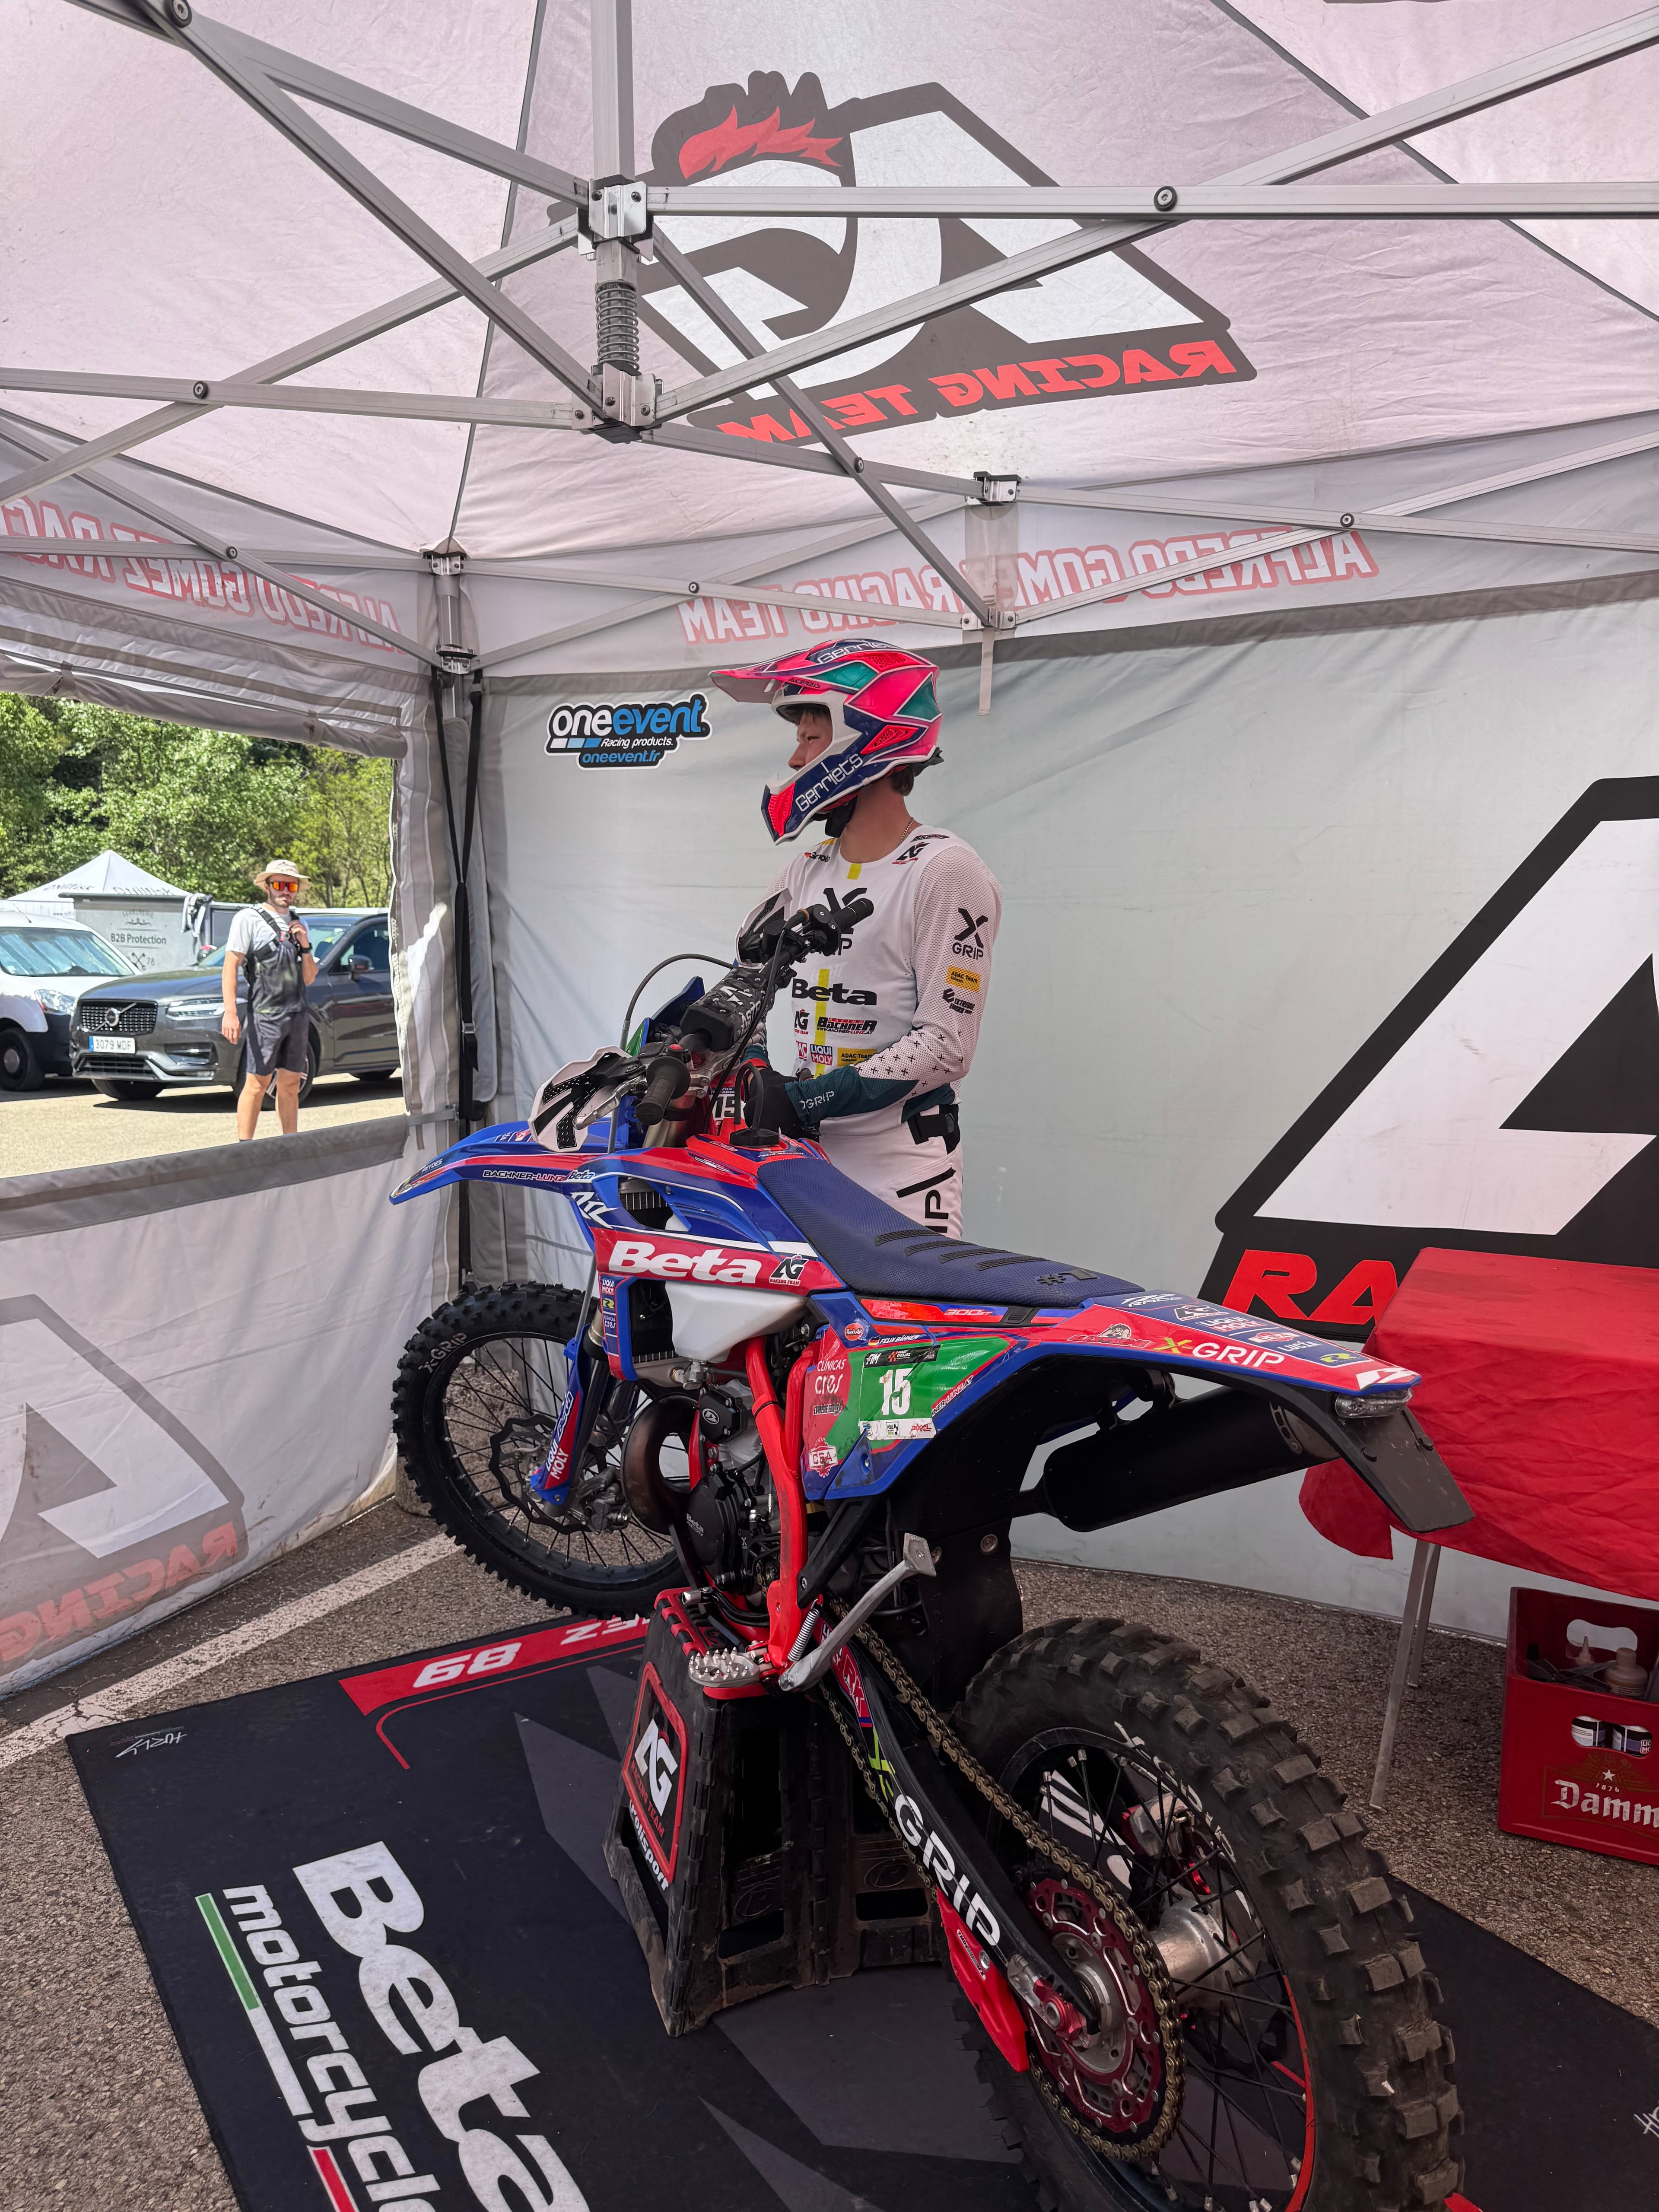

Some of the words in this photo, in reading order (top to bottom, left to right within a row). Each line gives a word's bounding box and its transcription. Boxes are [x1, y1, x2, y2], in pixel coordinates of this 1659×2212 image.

[553, 699, 702, 736] oneevent
[601, 737, 630, 749] Racing
[632, 736, 673, 749] products.
[582, 750, 660, 763] oneevent.fr
[111, 934, 125, 943] B2B
[127, 934, 166, 944] Protection
[952, 942, 983, 960] GRIP
[791, 978, 877, 1006] Beta
[95, 1039, 114, 1050] 3079
[811, 1045, 832, 1055] LIQUI
[812, 1054, 832, 1065] MOLY
[569, 1169, 596, 1181] Beta
[608, 1240, 762, 1284] Beta
[602, 1286, 614, 1294] MOLY
[1201, 1316, 1248, 1326] LIQUI
[1214, 1321, 1264, 1331] MOLY
[817, 1359, 846, 1372] CLÍNICAS
[866, 1353, 881, 1365] FIM
[880, 1368, 912, 1416] 15
[546, 1439, 559, 1471] LIQUI
[550, 1448, 569, 1479] MOLY
[686, 1513, 704, 1533] Beta
[1595, 1783, 1619, 1792] 1876
[1551, 1779, 1659, 1828] Damm
[648, 1803, 665, 1838] TEAM
[292, 1841, 591, 2212] Beta
